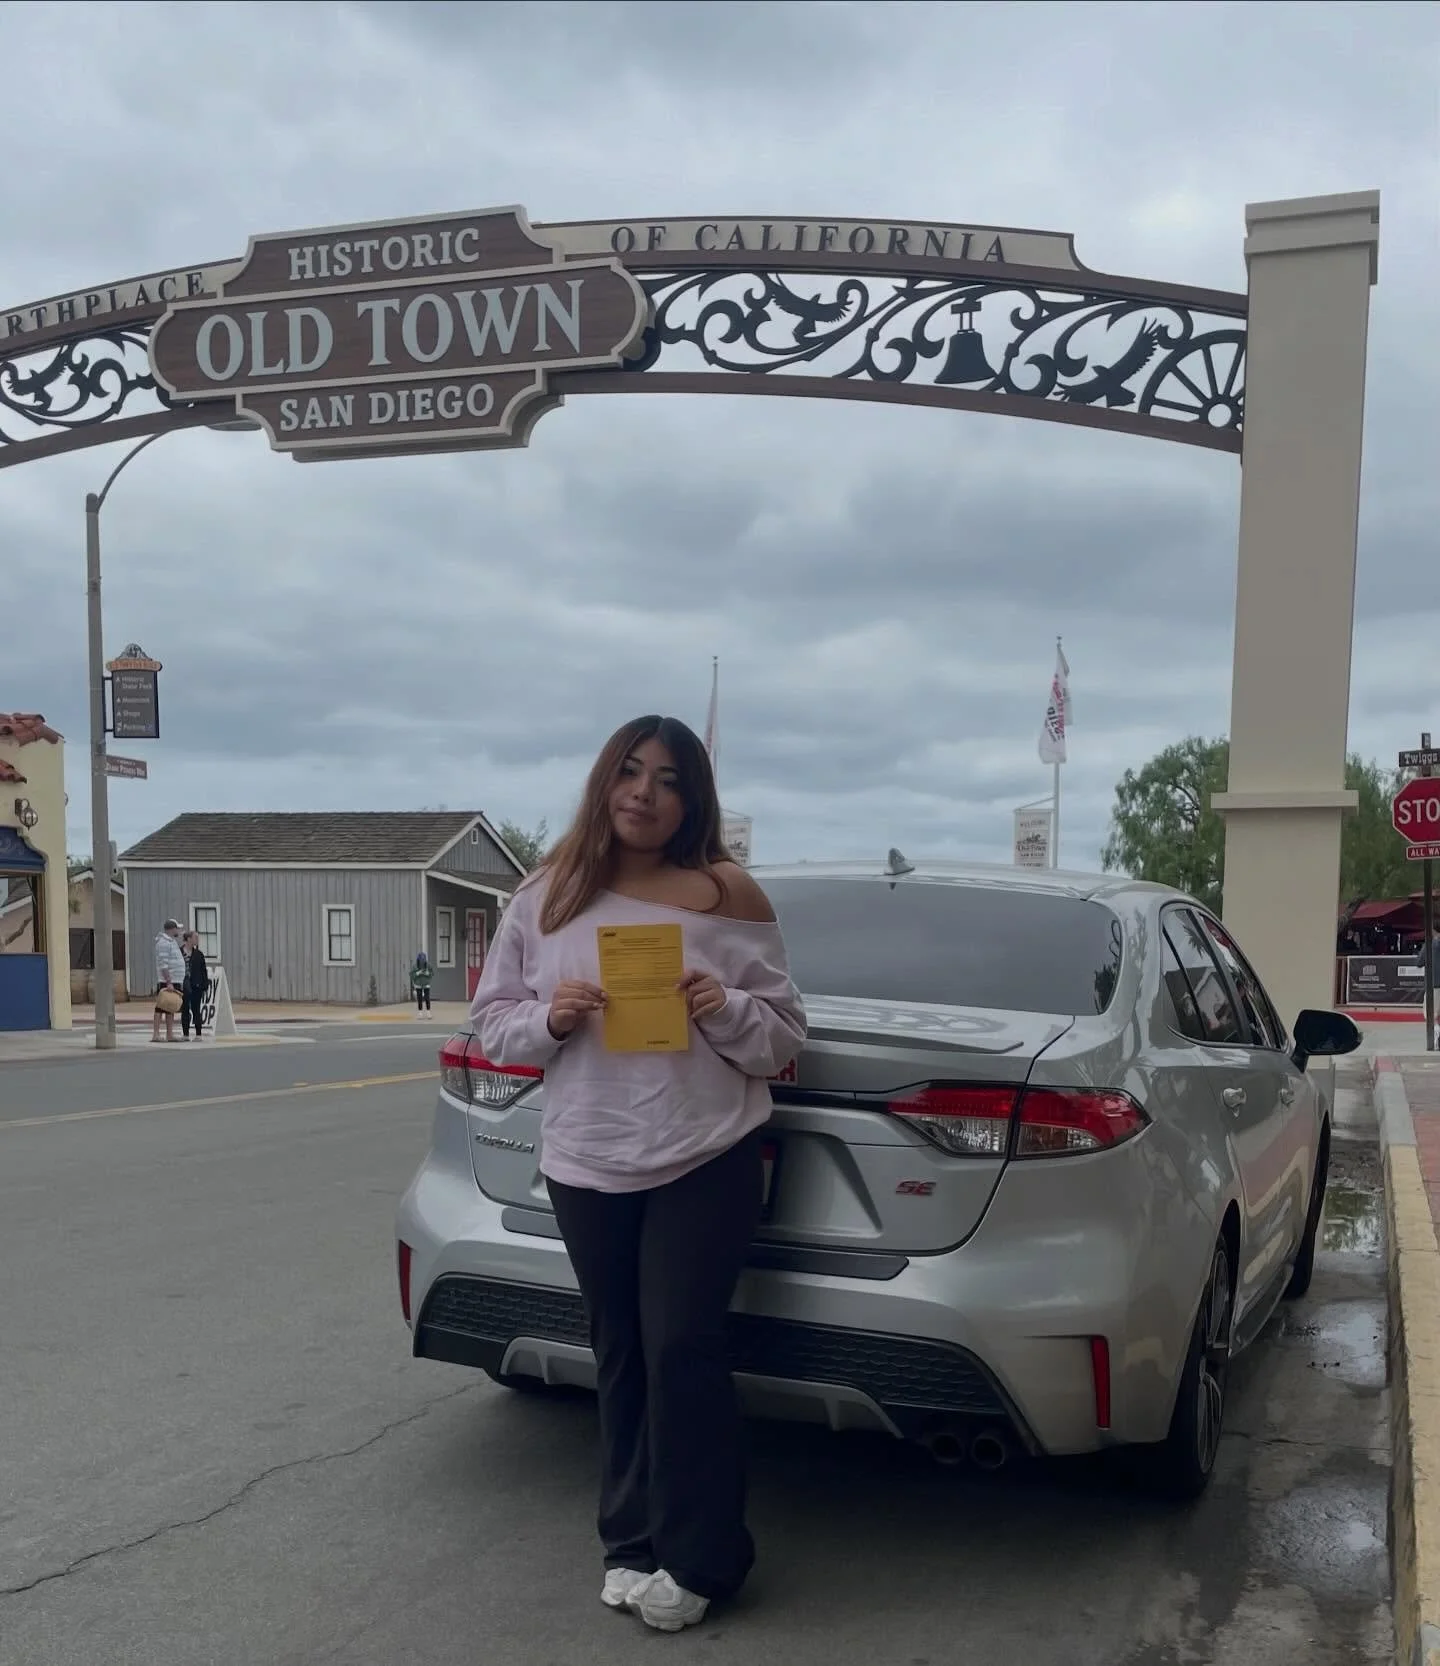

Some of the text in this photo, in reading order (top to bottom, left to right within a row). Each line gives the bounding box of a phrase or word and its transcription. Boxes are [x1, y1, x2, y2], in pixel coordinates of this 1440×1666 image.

[288, 228, 480, 281] HISTORIC
[611, 224, 1007, 264] OF CALIFORNIA
[6, 271, 205, 337] RTHPLACE
[196, 279, 585, 381] OLD TOWN
[279, 382, 495, 432] SAN DIEGO
[1410, 848, 1426, 857] ALL
[475, 1132, 535, 1154] COROLLA
[895, 1179, 937, 1197] SE
